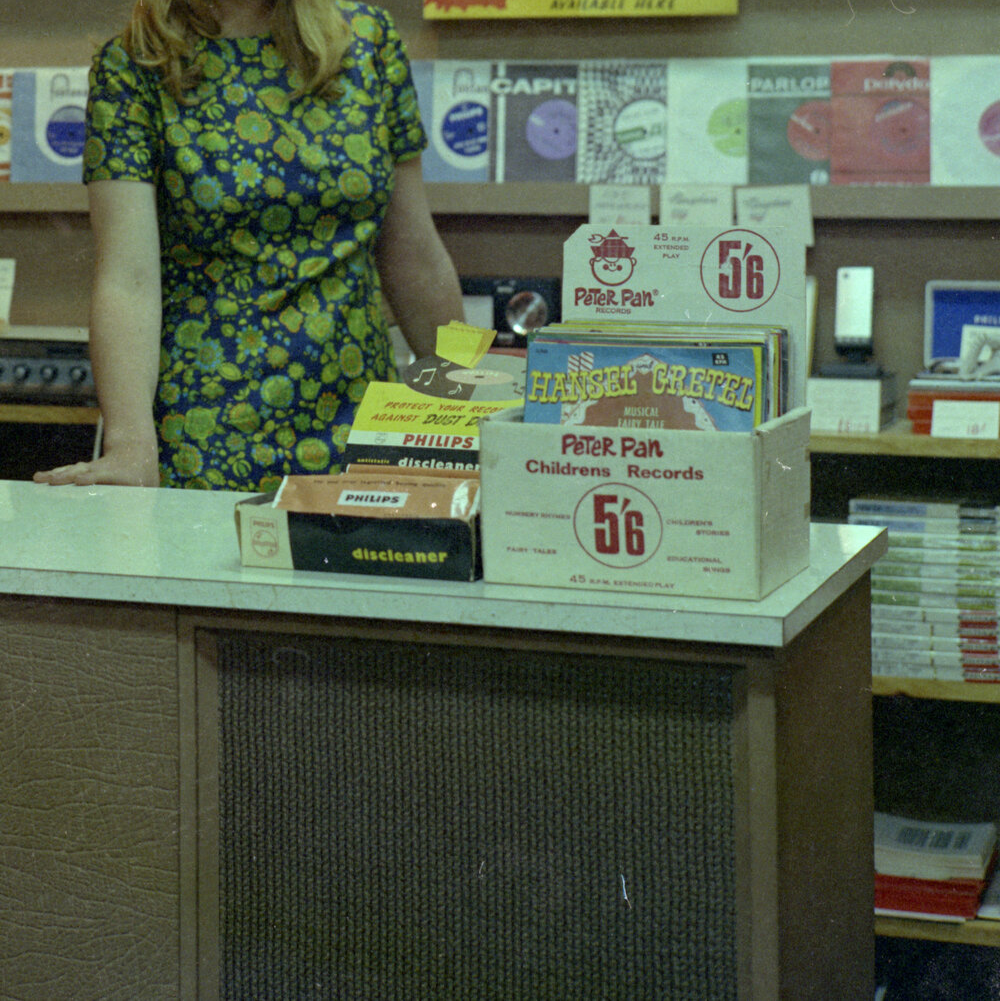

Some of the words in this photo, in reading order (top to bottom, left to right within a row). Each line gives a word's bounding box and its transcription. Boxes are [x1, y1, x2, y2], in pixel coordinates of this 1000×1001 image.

[652, 233, 669, 242] 45
[595, 307, 632, 315] RECORDS
[528, 364, 638, 404] HANSEL
[651, 362, 754, 412] GRETEL
[384, 401, 433, 411] PROTECT
[439, 404, 467, 413] YOUR
[623, 406, 660, 418] MUSICAL
[371, 413, 420, 423] AGAINST
[422, 413, 467, 426] DUST
[617, 418, 641, 429] FAIRY
[645, 419, 665, 429] TALE
[402, 433, 475, 449] PHILIPS
[525, 459, 611, 478] Childrens
[627, 464, 704, 481] Records
[345, 493, 400, 505] PHILIPS
[505, 510, 539, 518] NURSERY
[541, 512, 571, 520] RHYMES
[696, 529, 730, 537] STORIES
[352, 547, 448, 564] discleaner
[533, 547, 557, 555] TALES
[666, 555, 723, 564] EDUCATIONAL
[569, 574, 586, 584] 45
[613, 579, 655, 589] EXTENDED
[655, 581, 675, 590] PLAY
